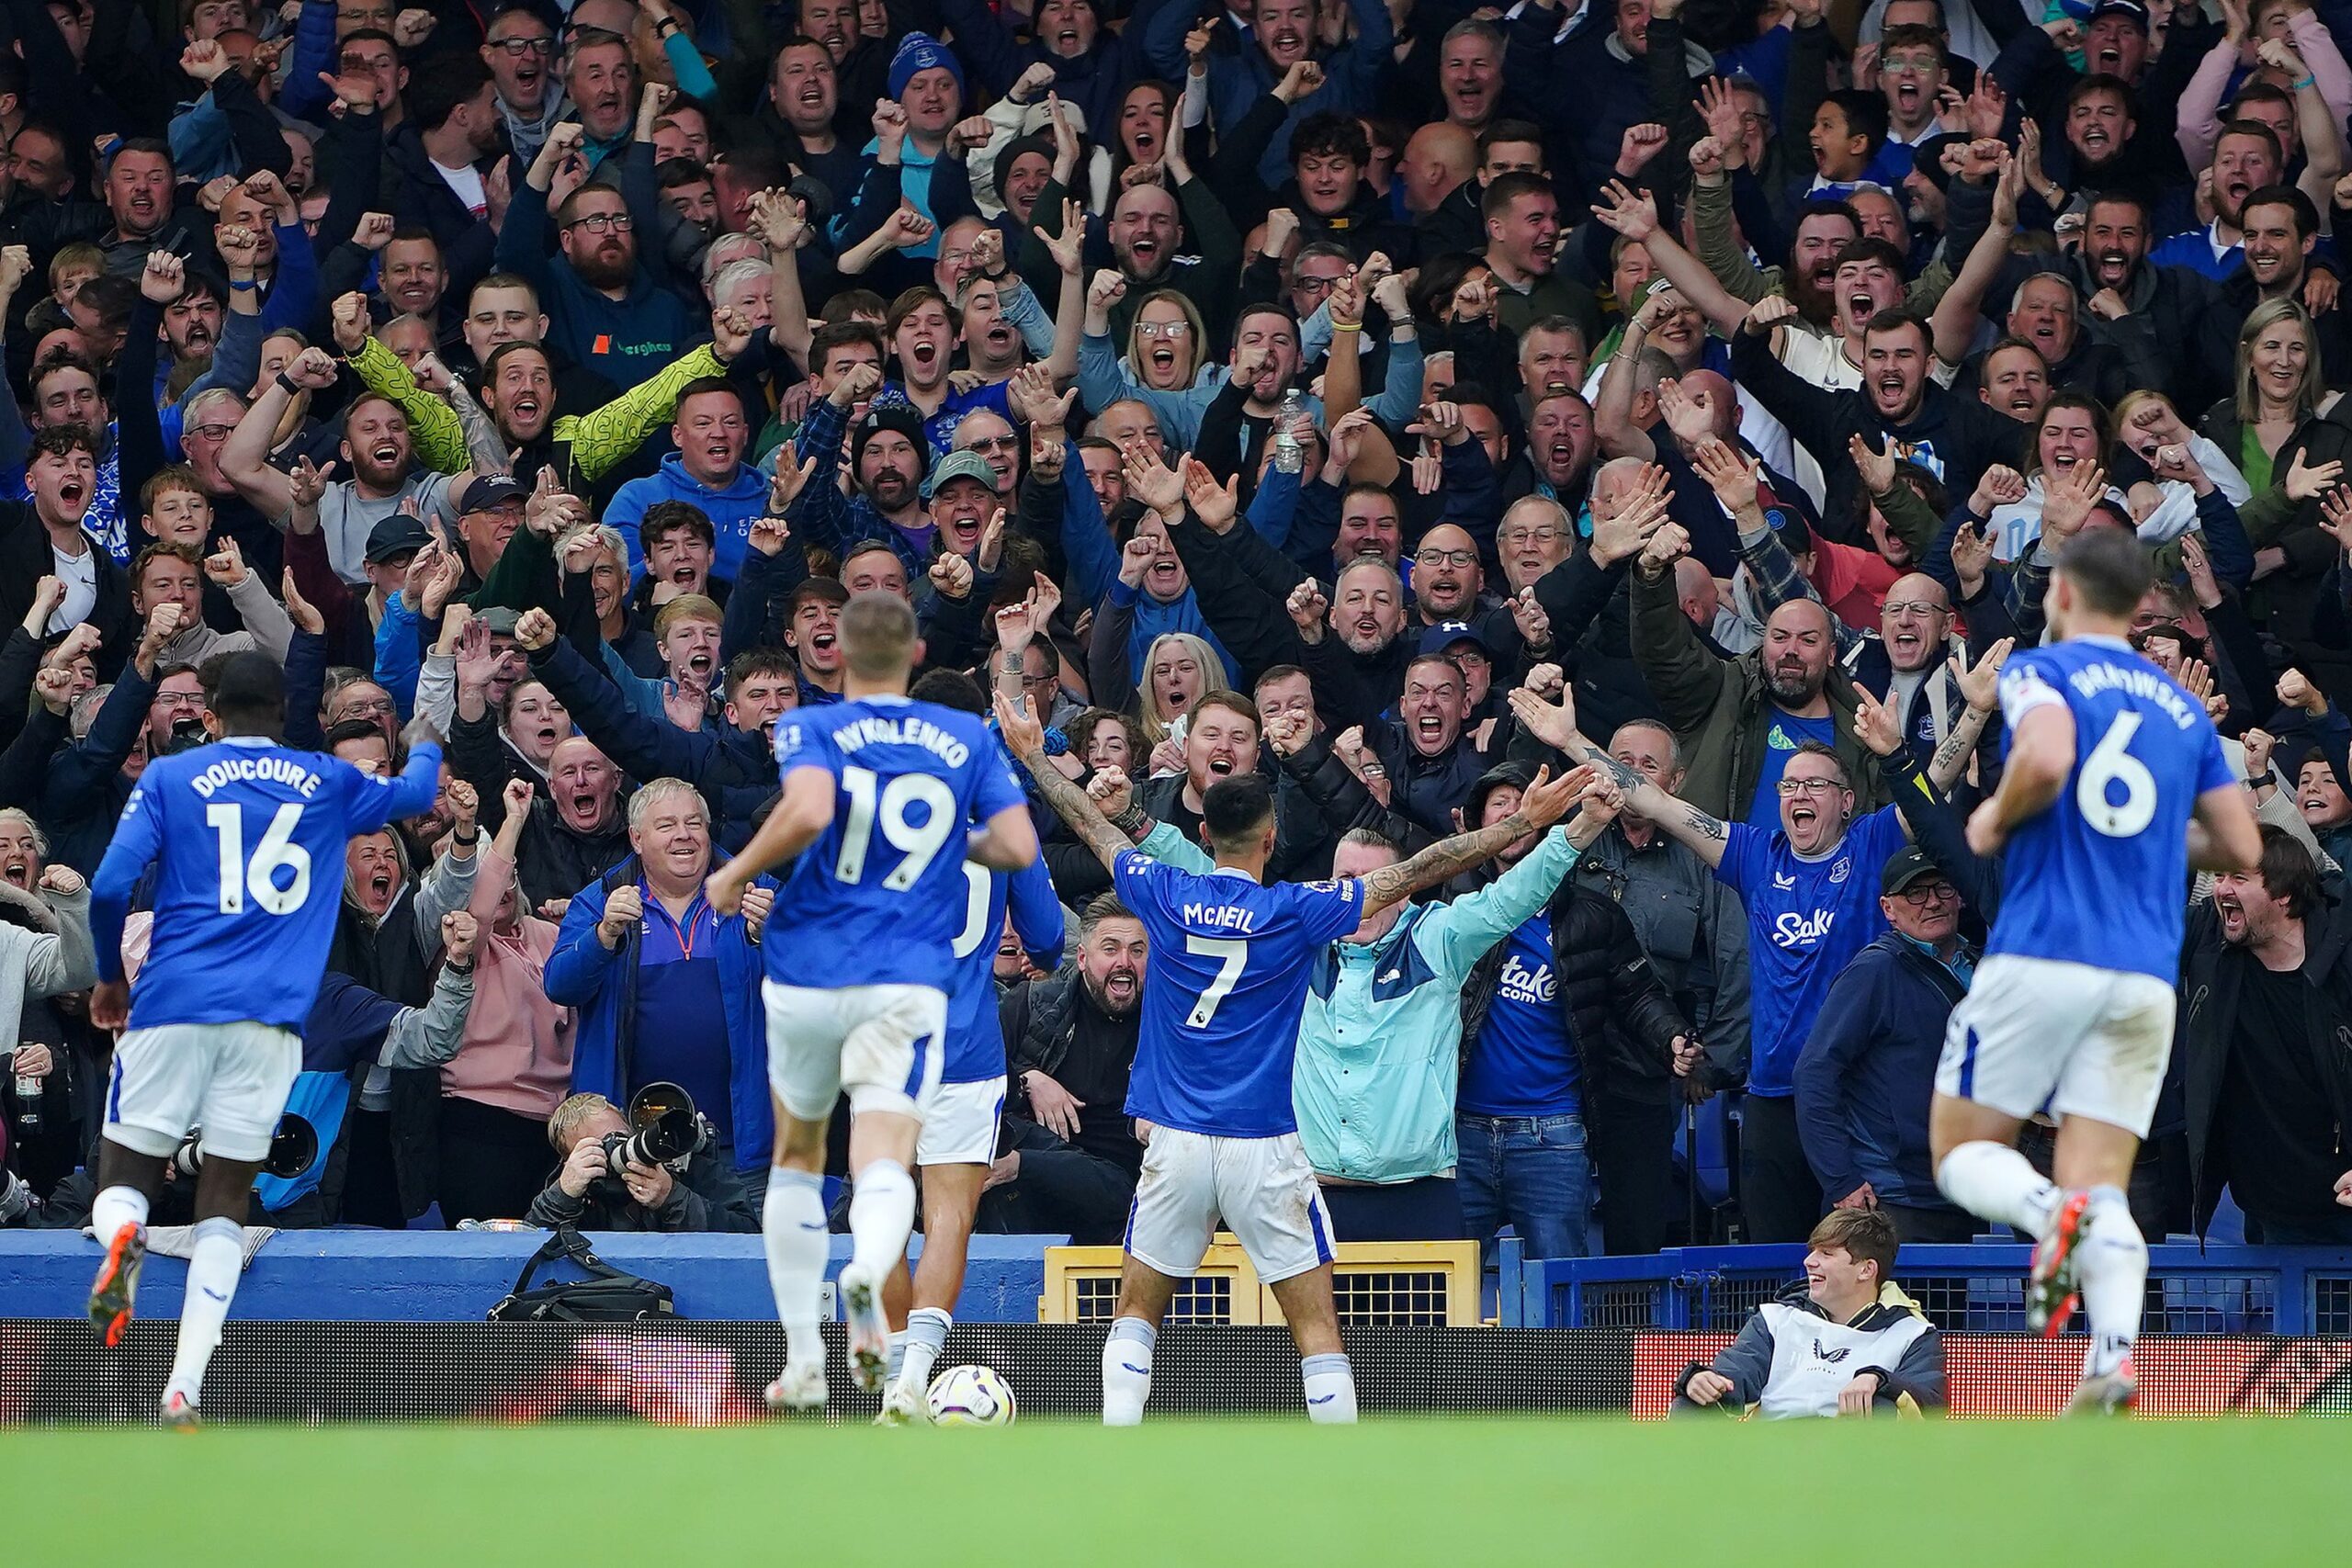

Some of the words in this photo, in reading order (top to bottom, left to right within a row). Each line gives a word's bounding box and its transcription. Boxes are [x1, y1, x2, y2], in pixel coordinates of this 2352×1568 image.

[191, 757, 322, 799] DOUCOURE
[2076, 709, 2157, 838] 6
[206, 802, 312, 916] 16
[834, 764, 956, 893] 19
[1184, 933, 1248, 1029] 7
[1497, 986, 1536, 1004] .com
